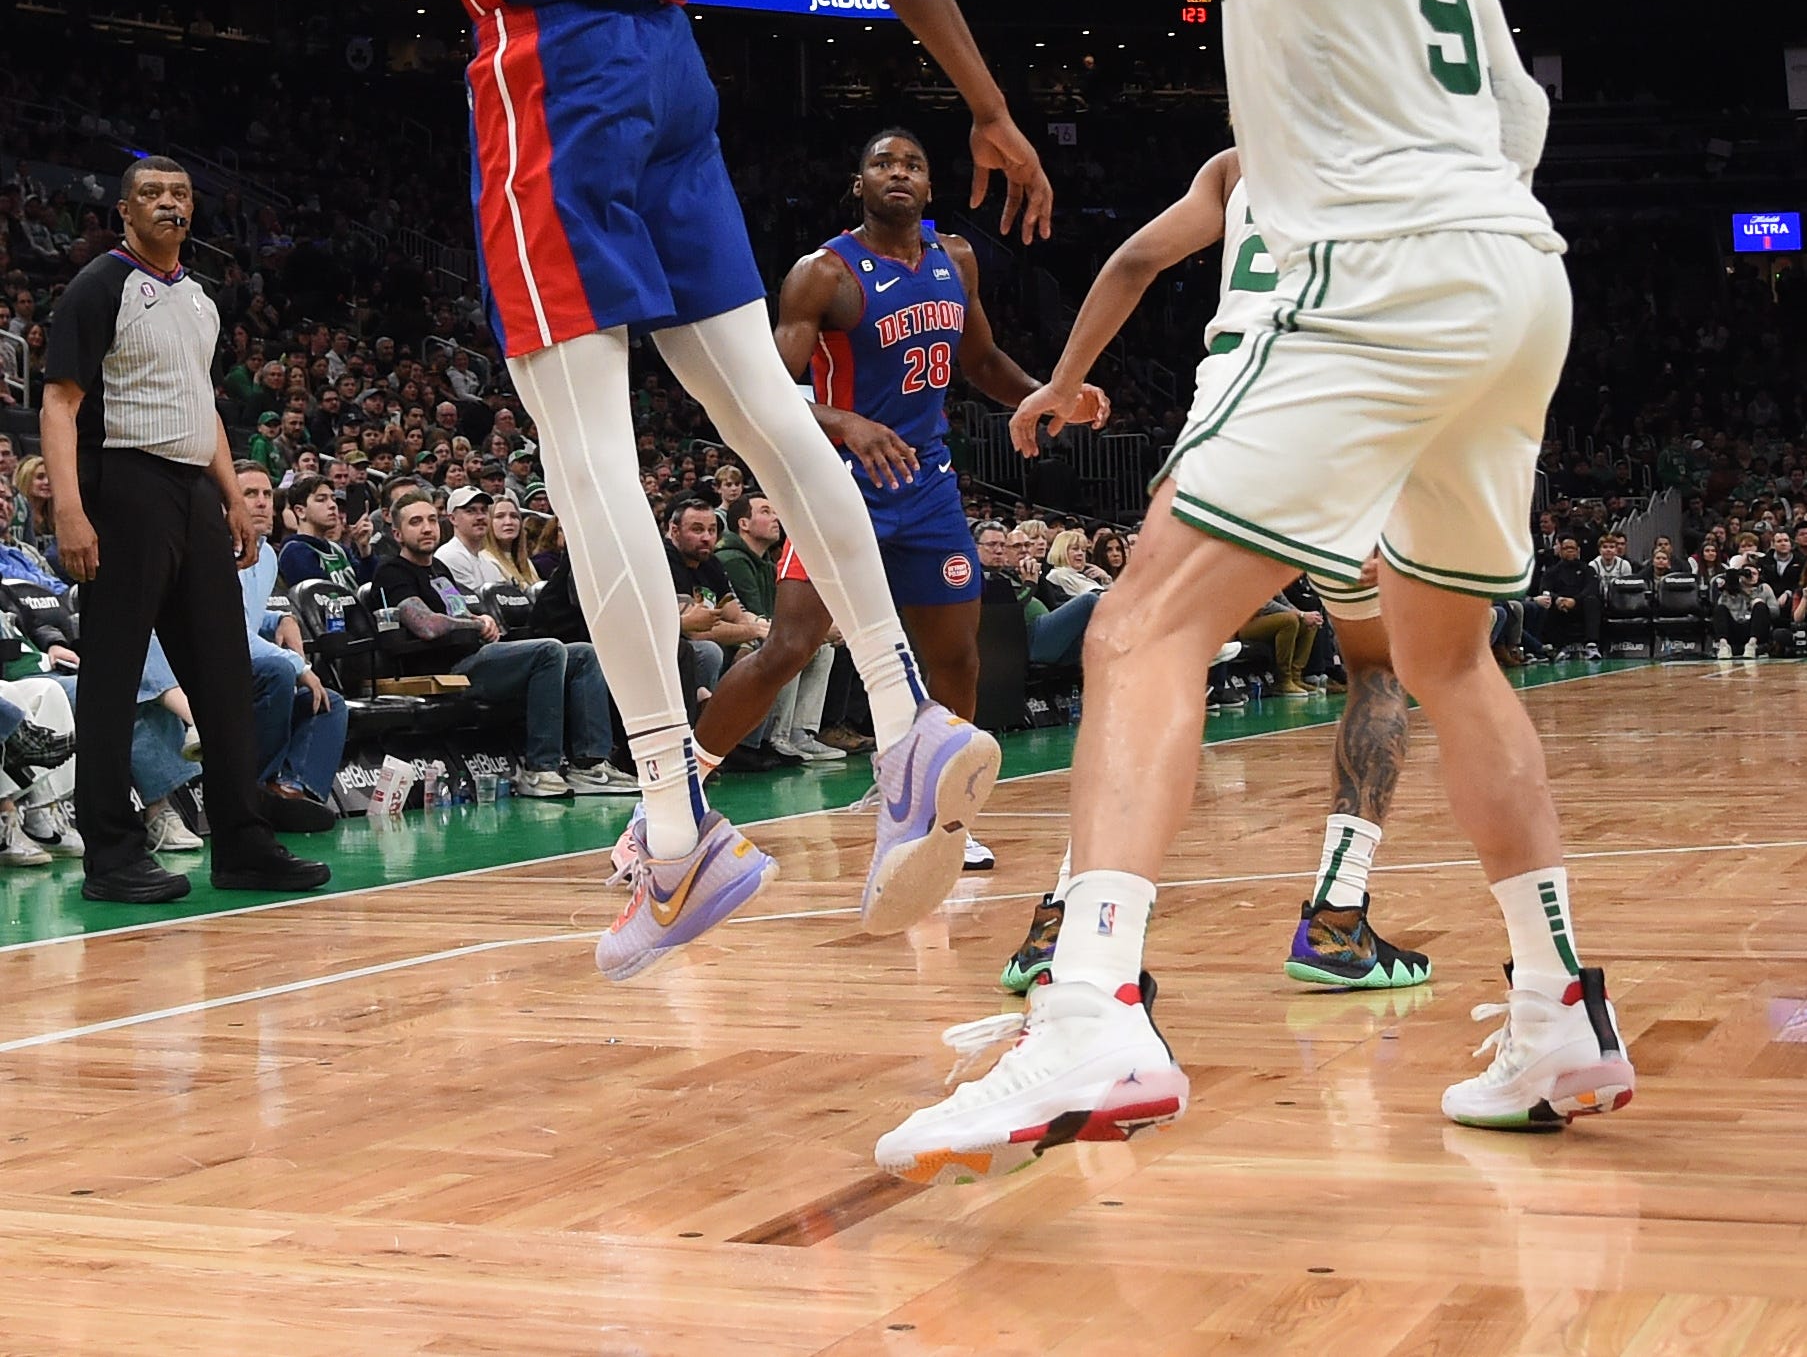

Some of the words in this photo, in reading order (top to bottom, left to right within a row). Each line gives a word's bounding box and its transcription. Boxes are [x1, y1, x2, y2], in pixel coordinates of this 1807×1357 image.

[1182, 7, 1206, 22] 123
[1743, 223, 1790, 235] ULTRA
[860, 259, 874, 272] 6
[874, 300, 964, 349] DETROIT
[902, 342, 950, 395] 28
[462, 752, 511, 776] jetBlue
